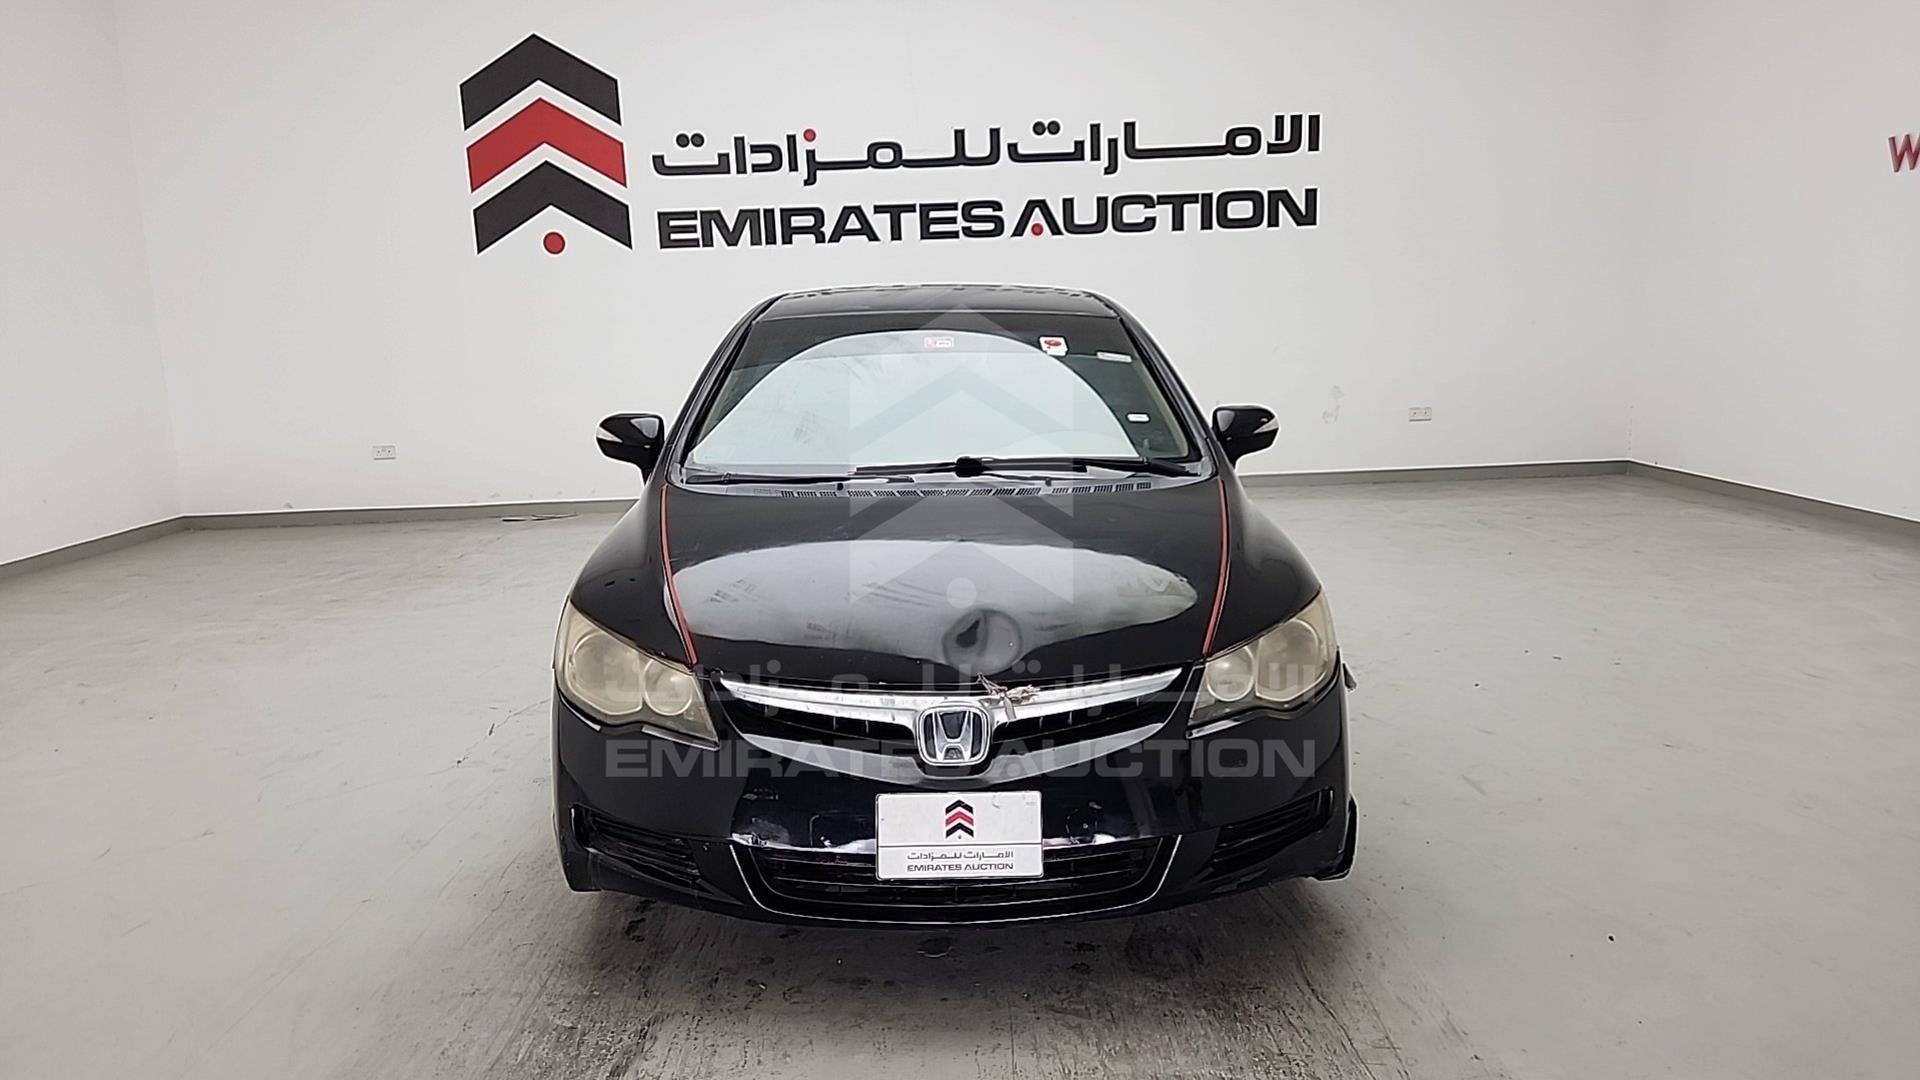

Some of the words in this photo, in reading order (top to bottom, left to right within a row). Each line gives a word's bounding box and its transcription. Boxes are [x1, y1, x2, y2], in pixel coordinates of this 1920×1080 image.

[651, 128, 1001, 187] للمزادات
[1007, 114, 1321, 176] الامارات
[657, 200, 1005, 250] EMIRATES
[1010, 187, 1318, 238] AUCTION
[907, 864, 962, 872] EMIRATES
[964, 863, 1013, 871] AUCTION
